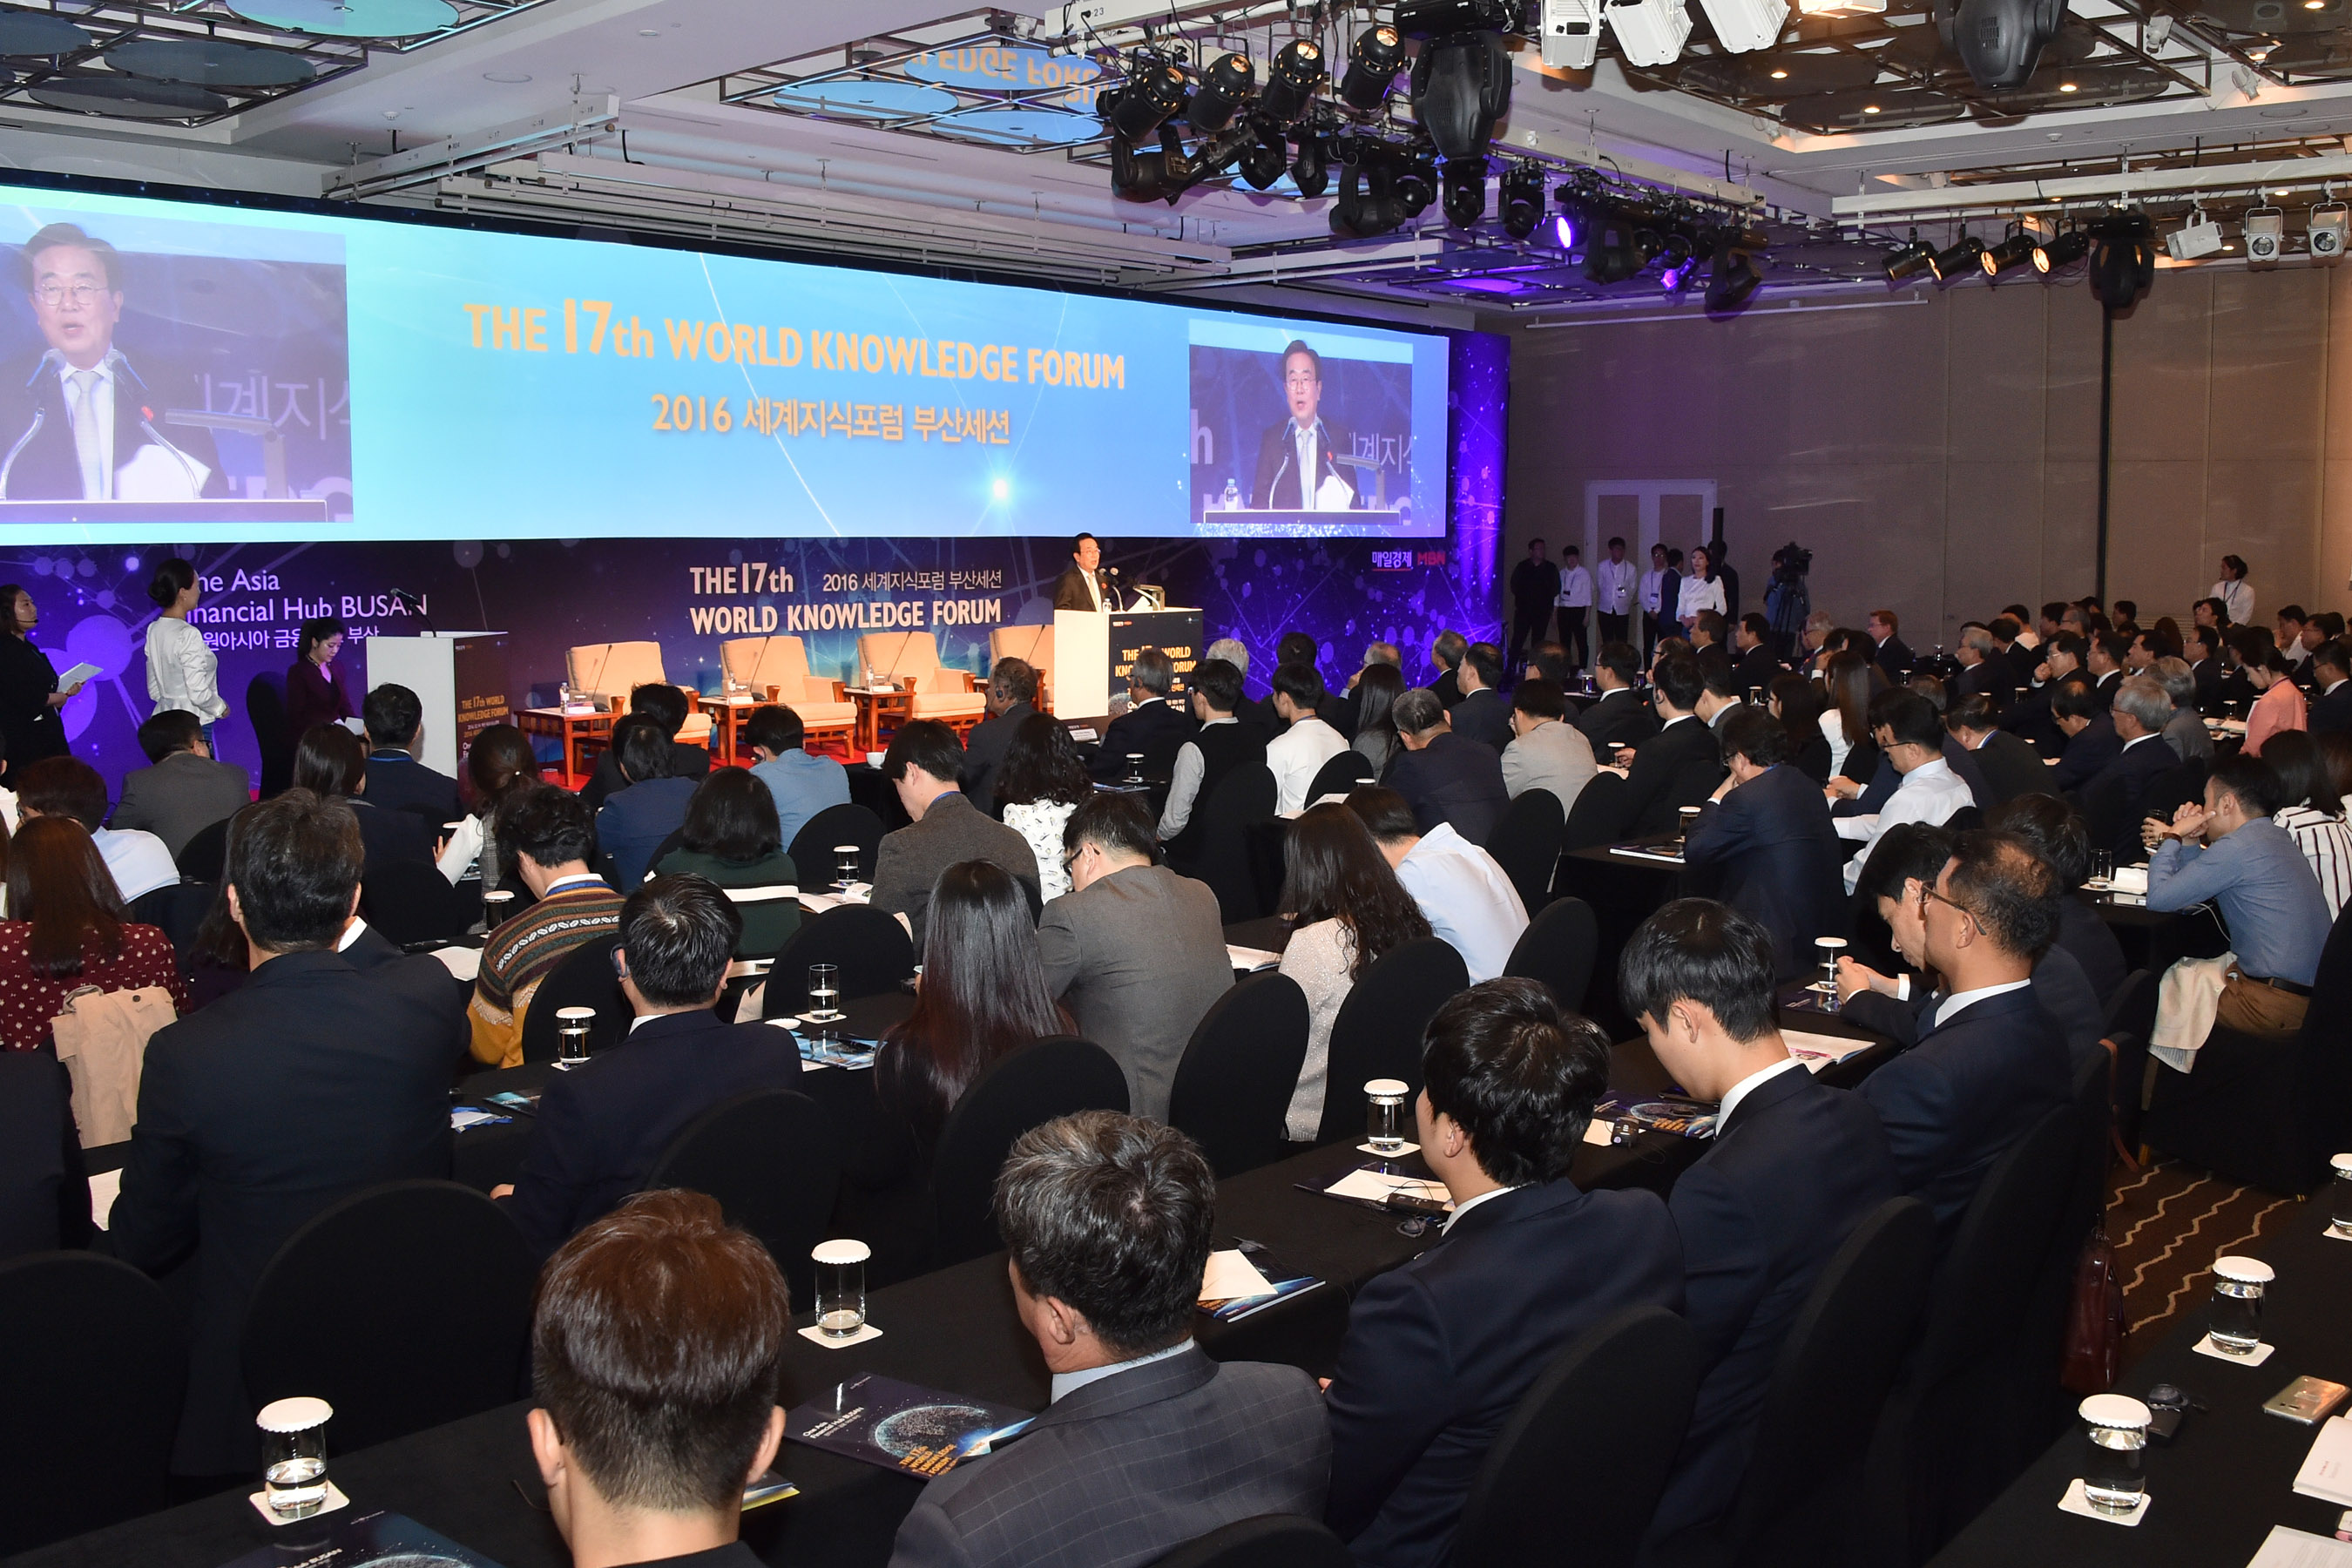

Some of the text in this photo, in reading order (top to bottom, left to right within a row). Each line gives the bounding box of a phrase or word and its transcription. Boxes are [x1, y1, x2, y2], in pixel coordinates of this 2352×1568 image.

[463, 298, 1125, 389] THE 17th WORLD KNOWLEDGE FORUM
[652, 394, 1010, 444] 2016 세계지식포럼 부산세션
[1372, 551, 1412, 569] 매일경제
[198, 568, 280, 592] ne Asia
[690, 563, 794, 594] THE 17th
[823, 569, 1002, 592] 2016 세계지식포럼 부산세션
[186, 598, 274, 625] inancial
[284, 597, 333, 619] Hub
[690, 598, 1001, 634] WORLD KNOWLEDGE FORUM
[1173, 660, 1196, 672] ORUM
[485, 695, 504, 705] WORLD
